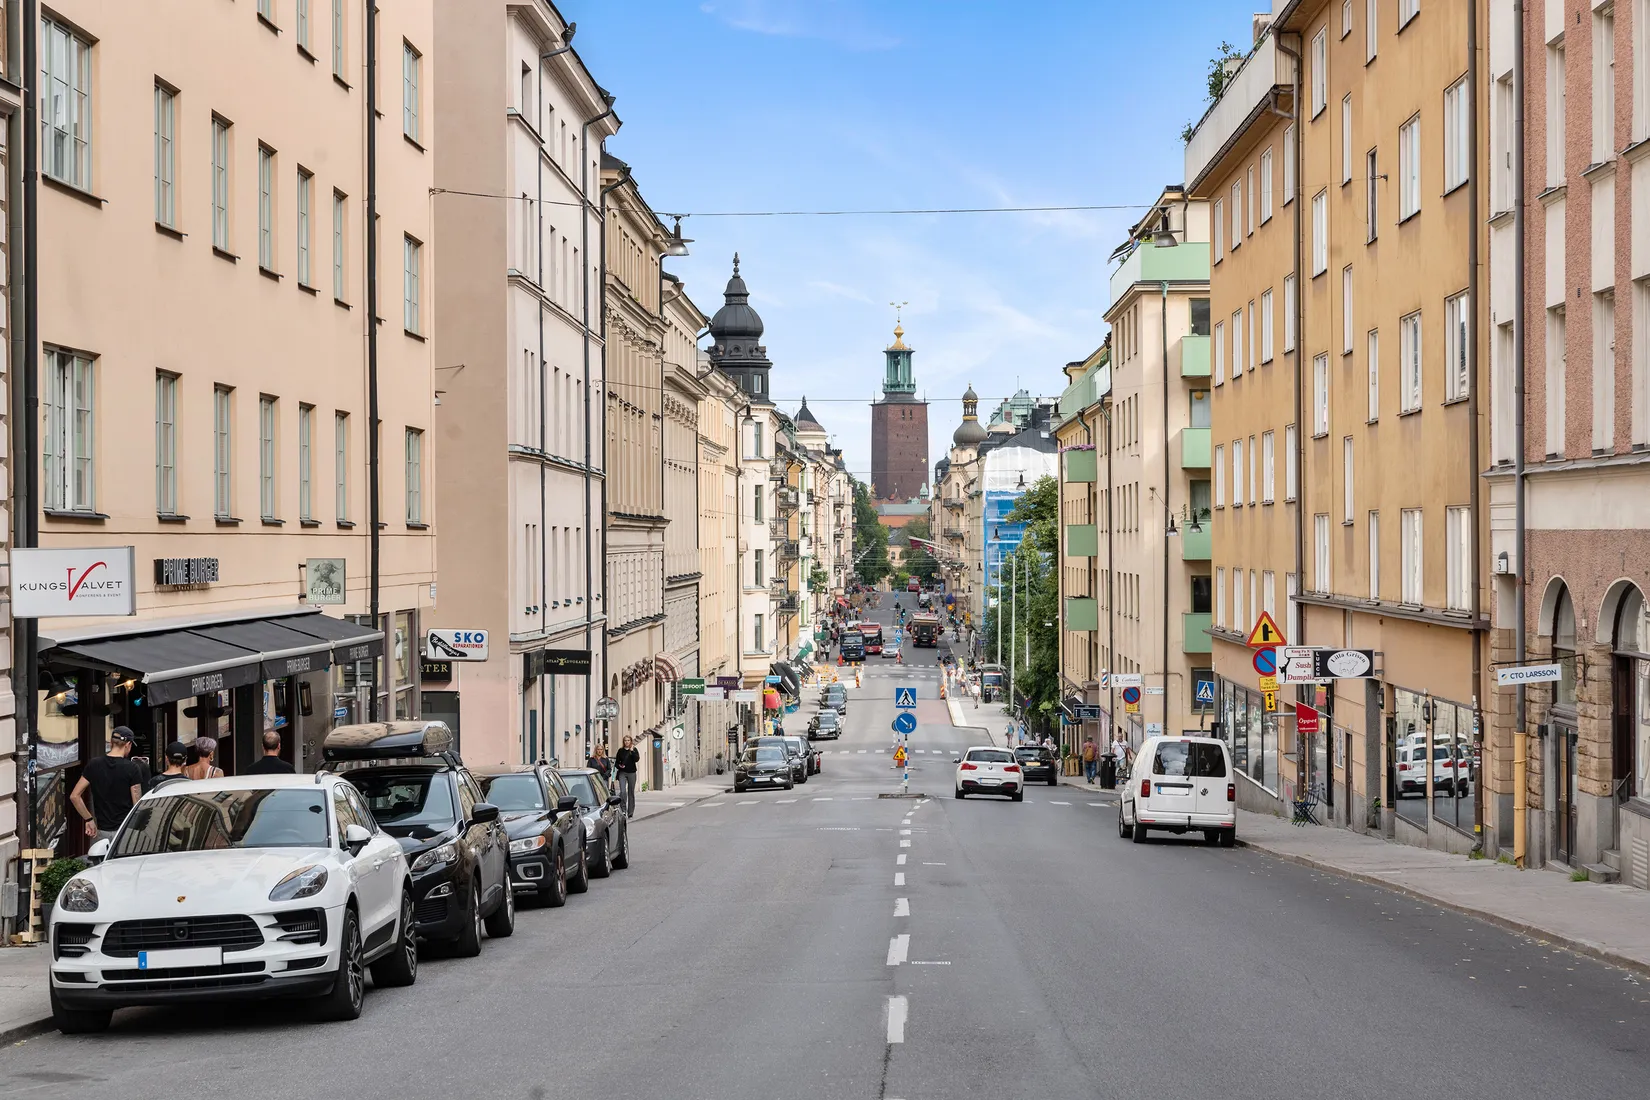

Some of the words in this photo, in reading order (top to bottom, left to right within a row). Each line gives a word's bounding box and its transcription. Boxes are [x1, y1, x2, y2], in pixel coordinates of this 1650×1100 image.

[163, 558, 189, 585] PRIME
[189, 557, 219, 583] BURGER
[312, 587, 338, 595] PRIME
[454, 632, 484, 643] SKO
[1526, 670, 1557, 678] LARSSON
[192, 678, 206, 694] PRIME
[206, 673, 224, 691] BURGER
